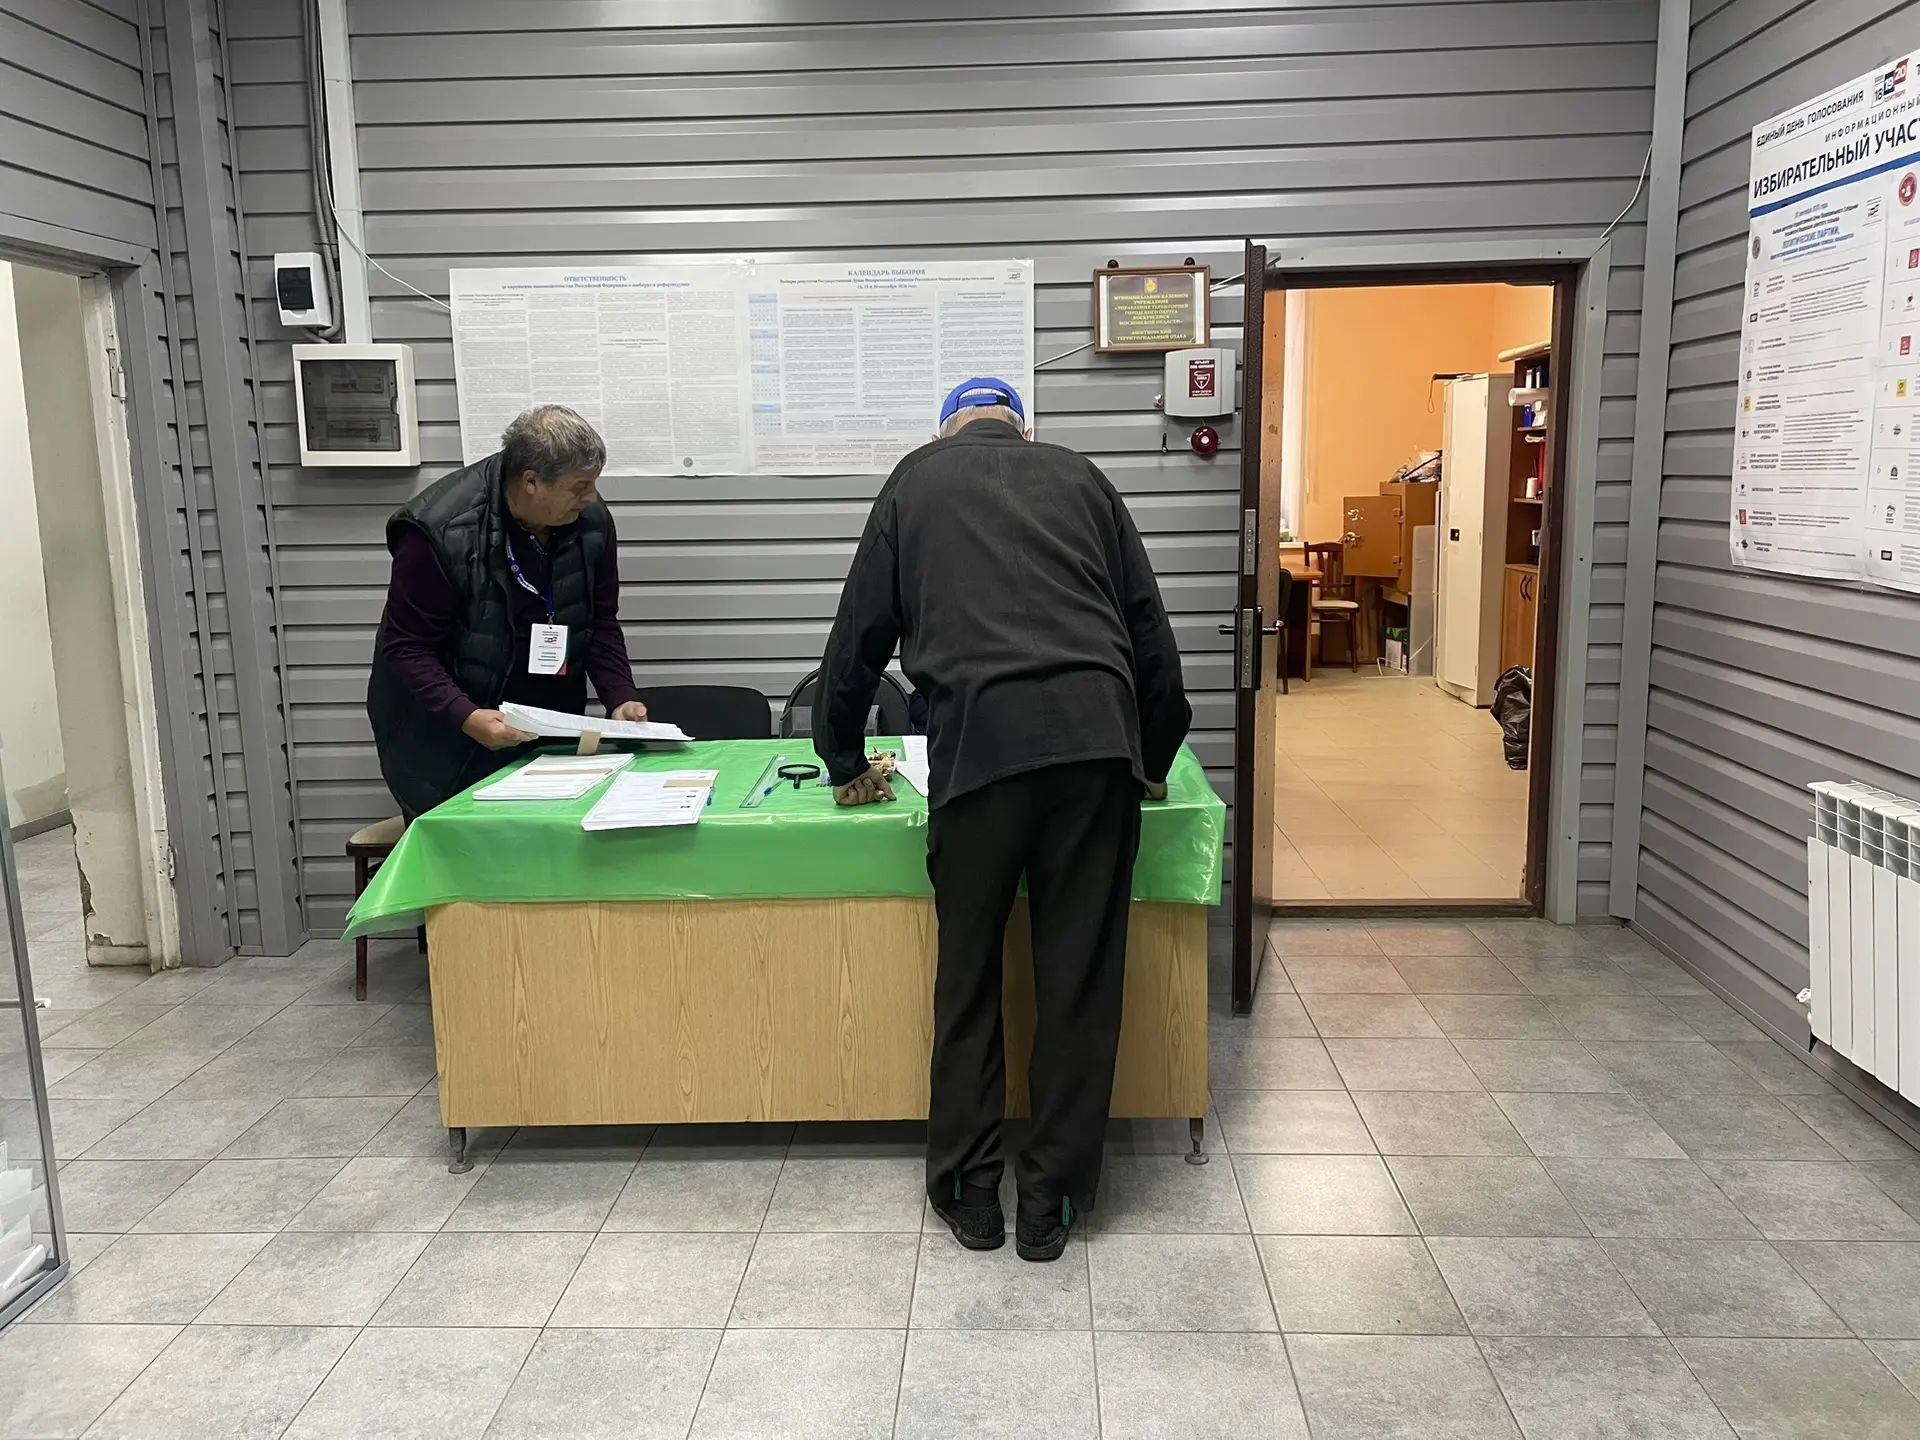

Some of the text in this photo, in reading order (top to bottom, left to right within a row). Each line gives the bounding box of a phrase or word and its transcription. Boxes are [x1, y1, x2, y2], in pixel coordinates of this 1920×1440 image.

[1885, 77, 1894, 90] 19
[1894, 64, 1907, 80] 20
[1756, 123, 1786, 147] ЕДИНЫЙ
[1786, 117, 1805, 138] ДЕНЬ
[1806, 90, 1865, 126] ГОЛОСОВАНИЯ
[1753, 118, 1920, 199] ИЗБИРАТЕЛЬНЫЙ УЧАС
[563, 275, 627, 283] ОТВЕТСТВЕННОСТЬ
[847, 268, 926, 277] КАЛЕНДАРЬ ВЫБОРОВ
